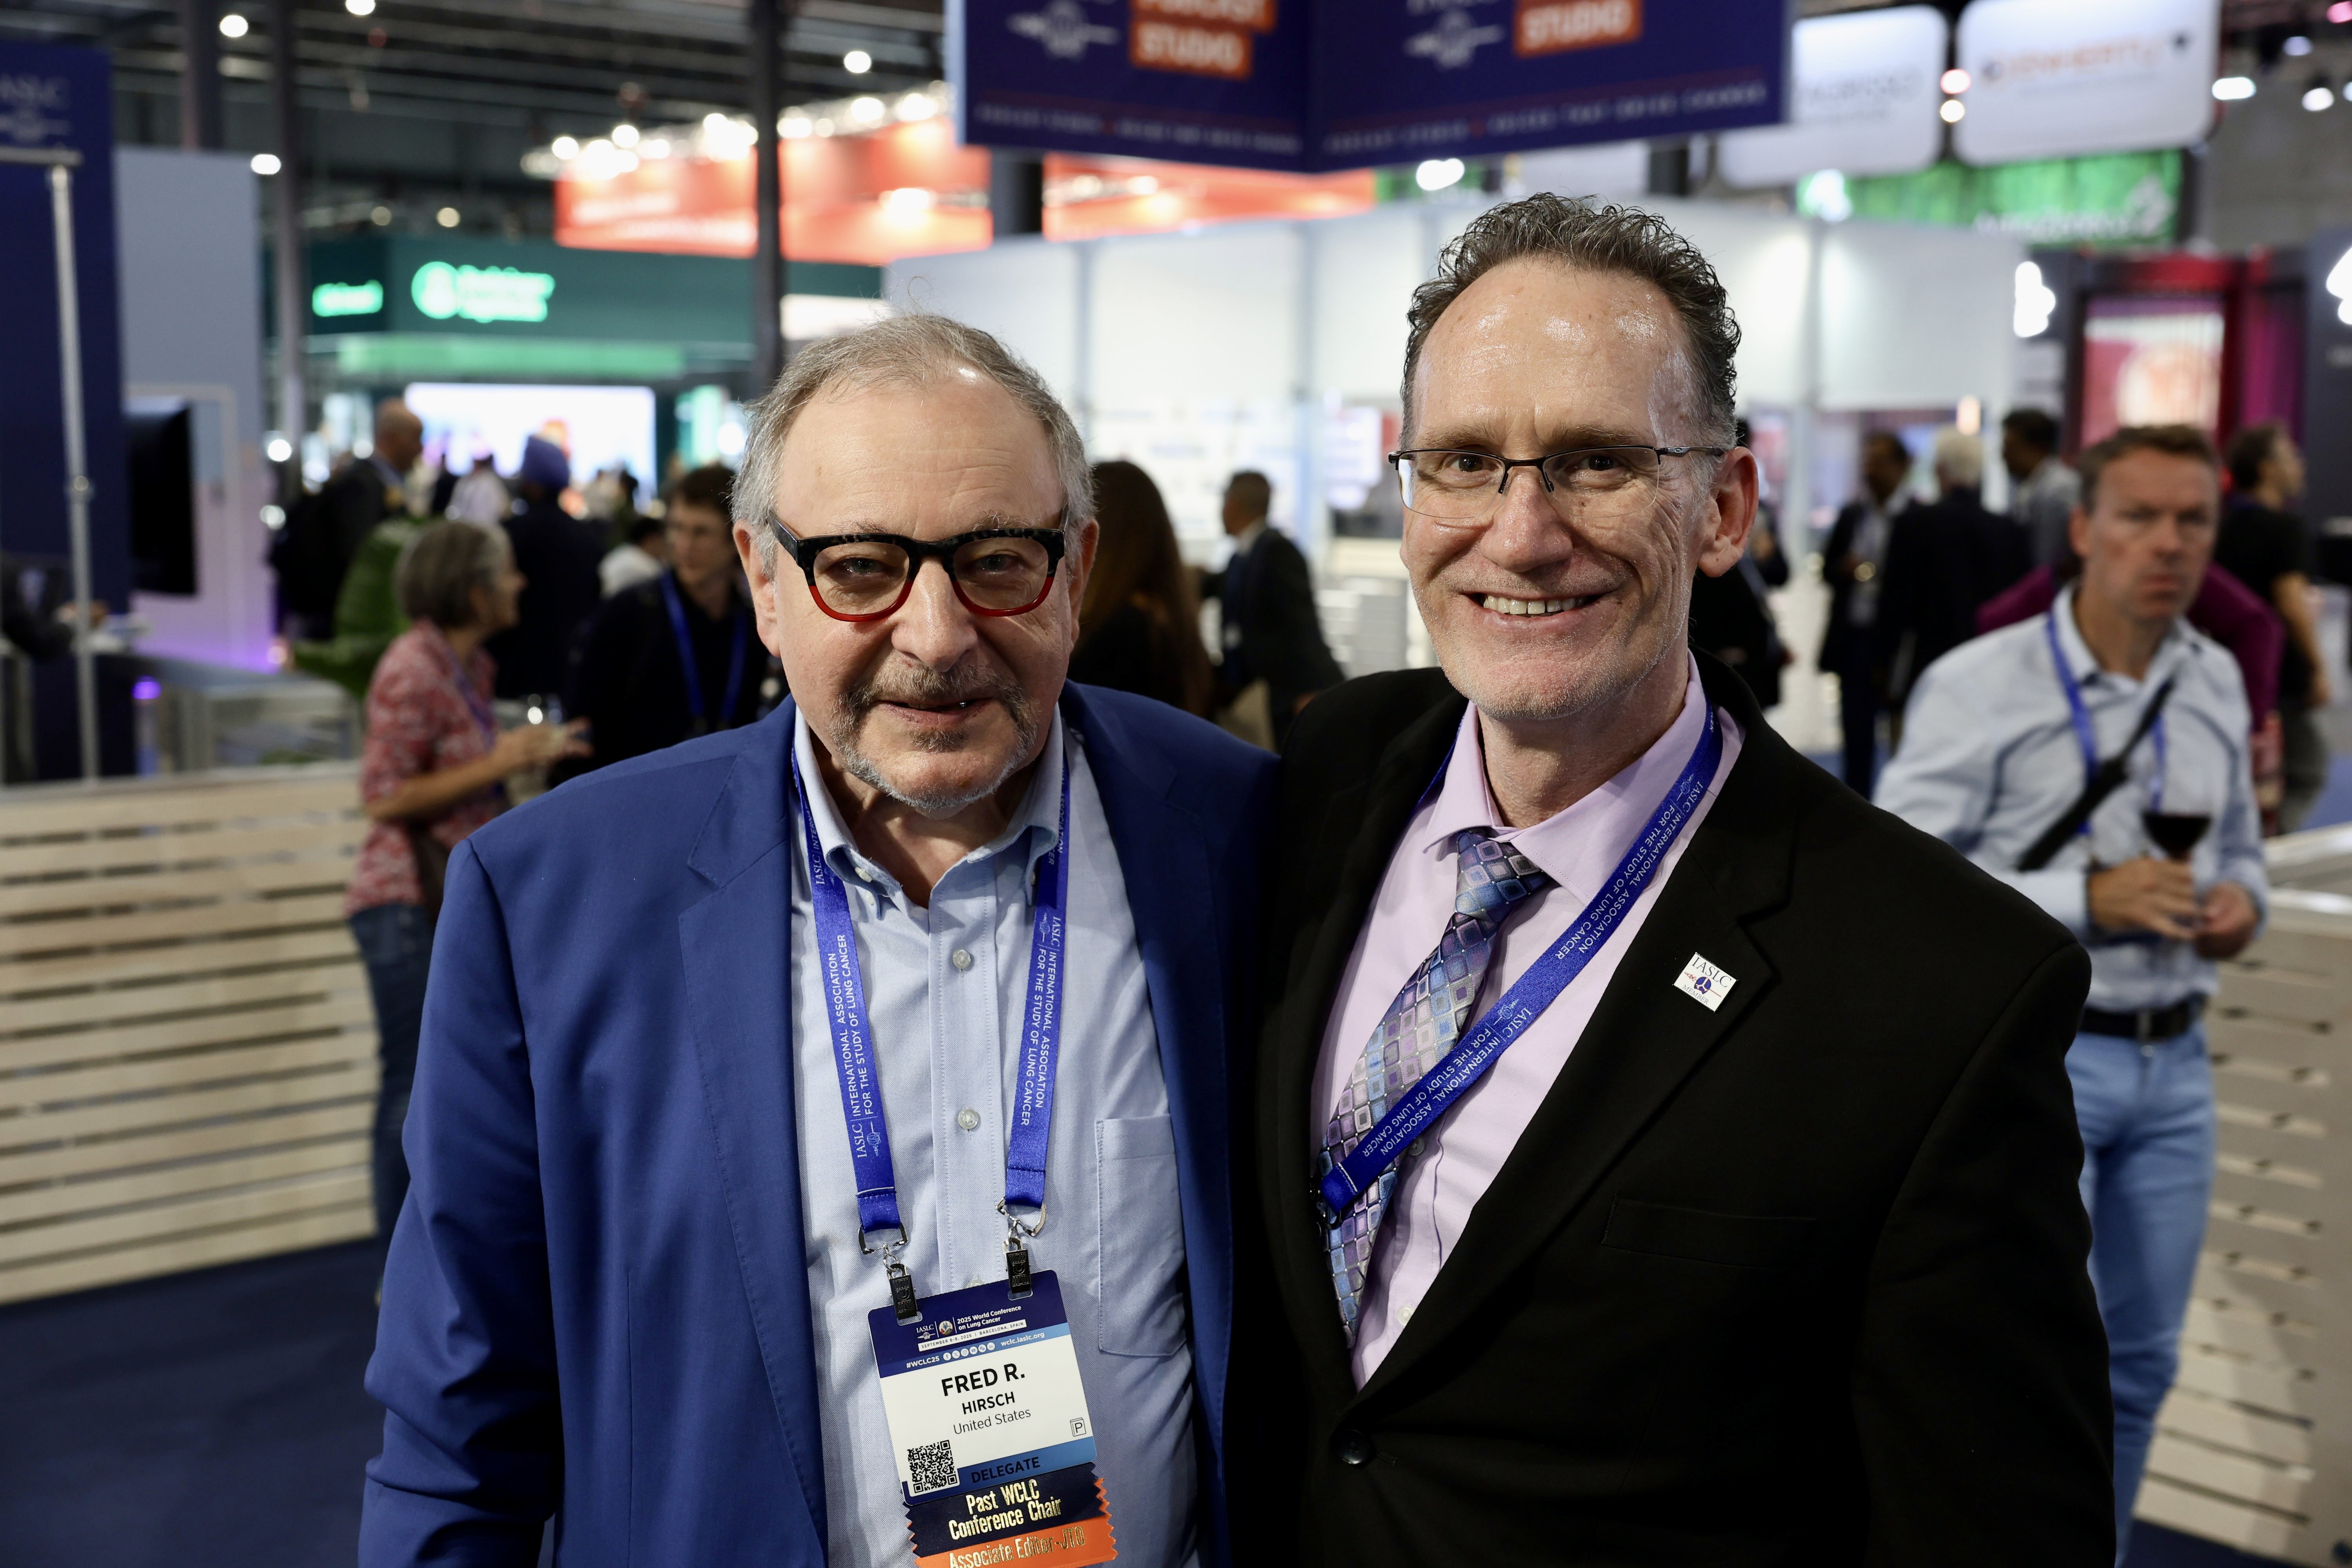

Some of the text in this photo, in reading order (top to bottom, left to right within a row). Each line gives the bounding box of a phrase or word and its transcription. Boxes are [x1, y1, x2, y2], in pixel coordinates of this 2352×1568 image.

[1682, 781, 1703, 813] IASLC
[812, 855, 825, 885] IASLC
[1555, 805, 1675, 959] FOR THE STUDY OF LUNG CANCER
[1579, 813, 1682, 953] INTERNATIONAL ASSOCIATION
[1051, 916, 1061, 947] IASLC
[1691, 956, 1731, 987] IASLC
[1682, 984, 1709, 1005] MEMBER
[828, 953, 861, 1116] INTERNATIONAL ASSOCIATION
[837, 935, 873, 1115] FOR THE STUDY OF LUNG CANCER
[1021, 948, 1046, 1125] FOR THE STUDY OF LUNG CANCER
[1035, 951, 1057, 1108] INTERNATIONAL ASSOCIATION
[1502, 1008, 1532, 1038] IASLC
[1362, 1029, 1491, 1157] FOR THE STUDY OF LUNG CANCER
[1380, 1036, 1501, 1155] INTERNATIONAL ASSOCIATION
[852, 1123, 867, 1158] IASLC
[916, 1324, 934, 1334] IASLC
[957, 1305, 1022, 1324] 2025 World Conference
[966, 1321, 981, 1329] Lung
[982, 1317, 1001, 1325] Cancer
[921, 1339, 948, 1348] SEPTEMBER
[980, 1326, 1009, 1335] BARCELONA,
[1000, 1332, 1045, 1347] wclc.iaslc.org
[906, 1356, 940, 1368] #WCLC25
[941, 1363, 1025, 1396] FRED R.
[962, 1392, 1015, 1415] HIRSCH
[953, 1409, 1031, 1434] United States
[971, 1457, 1040, 1483] DELEGATE
[966, 1479, 1040, 1515] Past WCLC
[949, 1496, 1061, 1540] Conference Chair
[949, 1544, 1014, 1568] Associate
